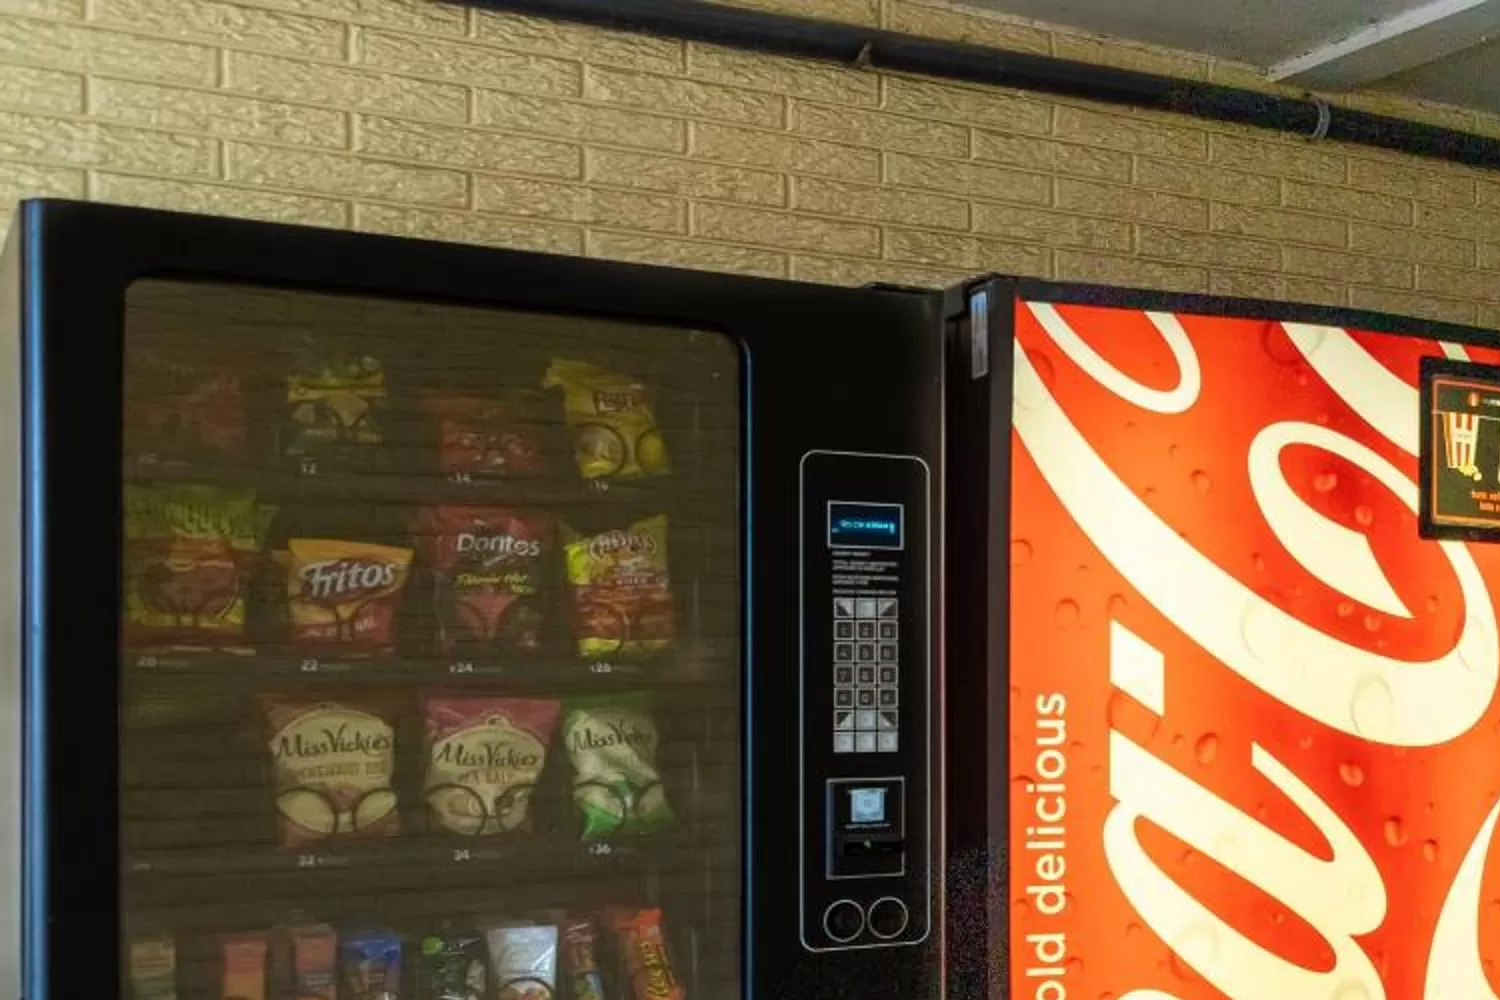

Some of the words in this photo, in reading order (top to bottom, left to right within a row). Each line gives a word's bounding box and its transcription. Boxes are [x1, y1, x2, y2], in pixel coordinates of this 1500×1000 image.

[456, 532, 541, 557] Doritos
[300, 559, 396, 598] Fritos
[1026, 692, 1066, 915] delicious
